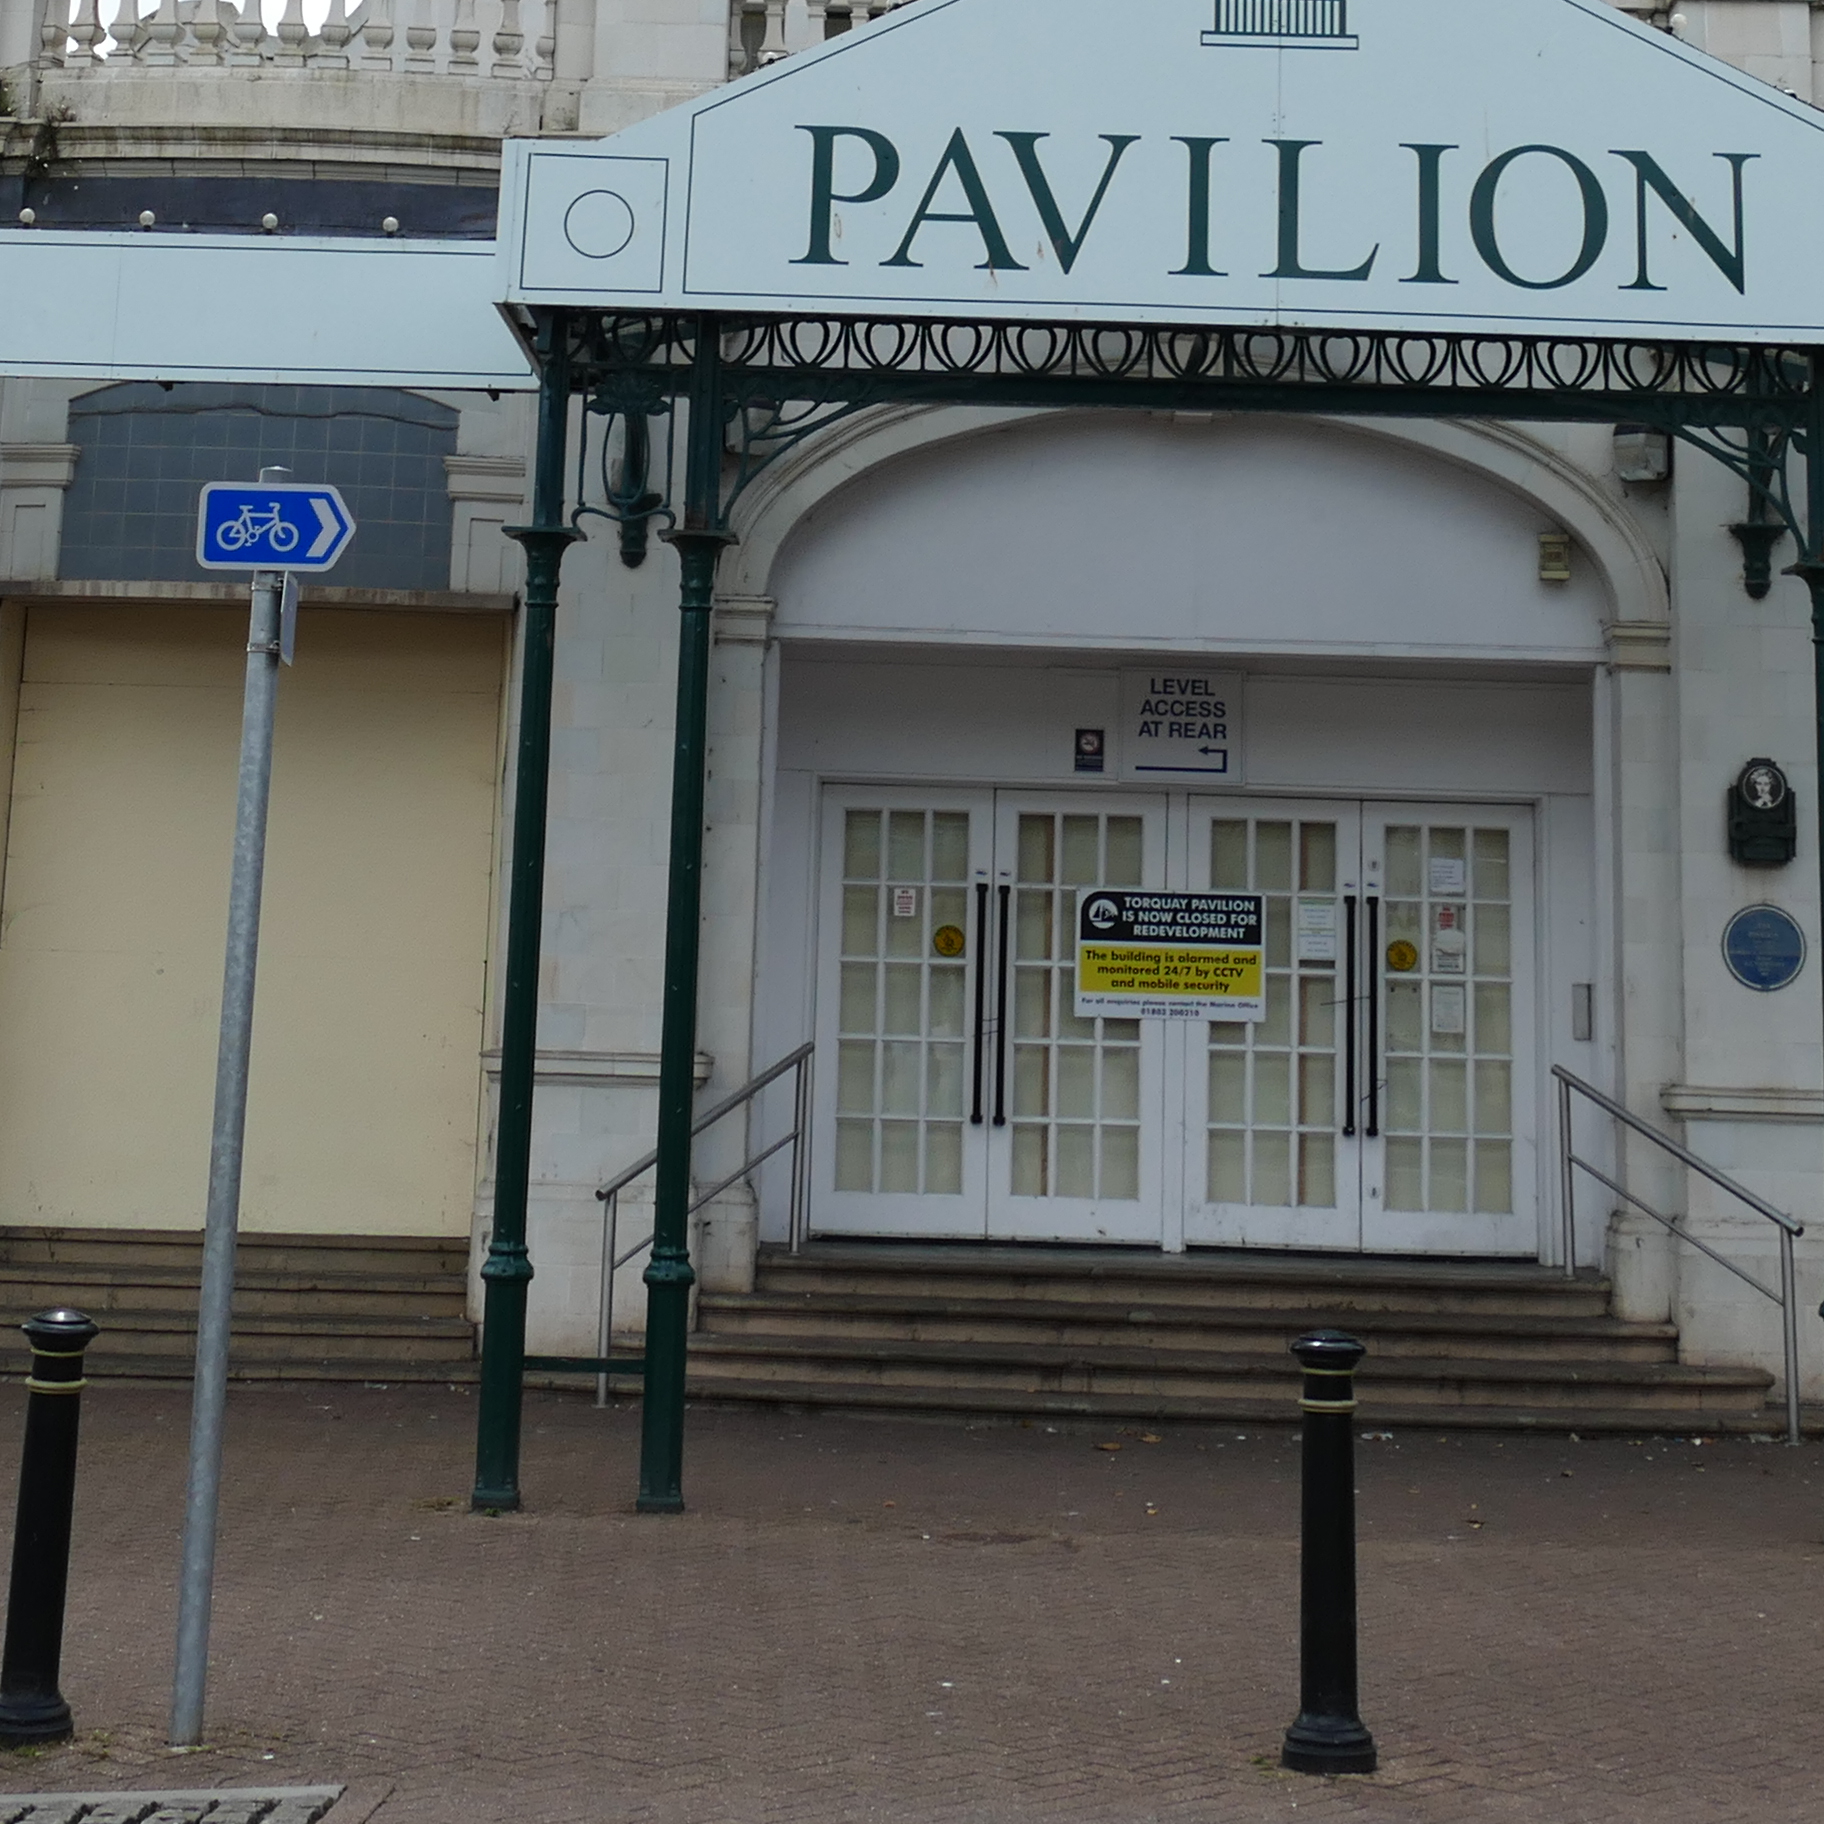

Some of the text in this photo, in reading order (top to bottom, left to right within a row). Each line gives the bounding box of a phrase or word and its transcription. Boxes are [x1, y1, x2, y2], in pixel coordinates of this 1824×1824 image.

[786, 123, 1762, 297] PAVILION
[1150, 678, 1216, 696] LEVEL
[1140, 699, 1226, 718] ACCESS
[1138, 721, 1227, 739] AT REAR
[1124, 897, 1255, 912] TORQUAY PAVILION
[1122, 911, 1257, 925] IS NOW CLOSED FOR
[1133, 925, 1246, 939] REDEVELOPMENT
[1085, 950, 1257, 965] The building is alarmed and
[1097, 965, 1244, 979] monitored 24/7 by CCTV
[1111, 978, 1230, 993] and mobile security
